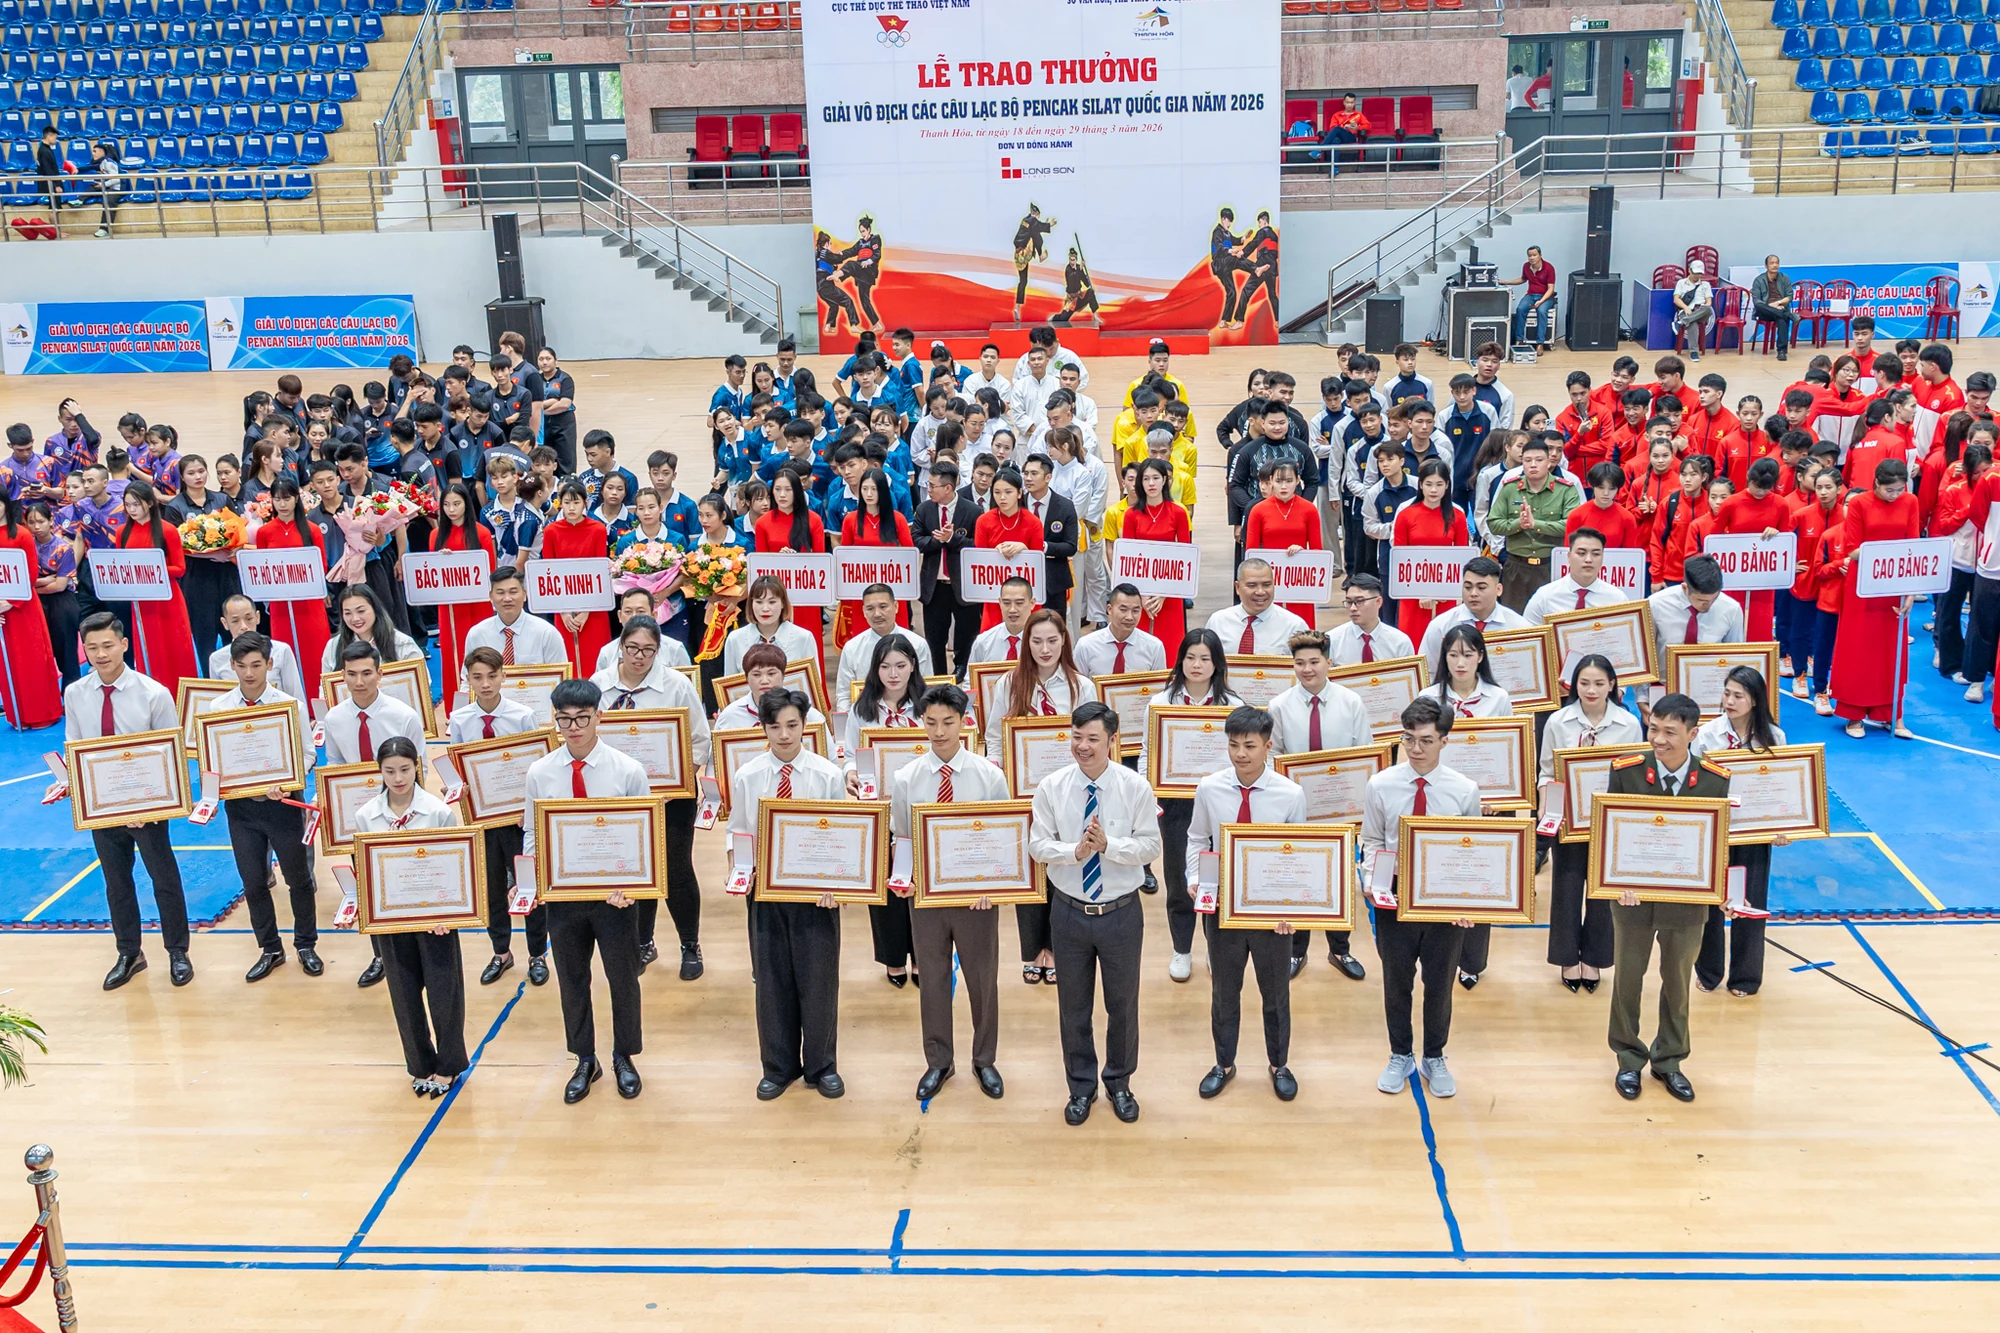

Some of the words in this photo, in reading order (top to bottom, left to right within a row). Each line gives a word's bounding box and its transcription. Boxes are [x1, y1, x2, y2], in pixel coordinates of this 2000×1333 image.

[832, 3, 848, 14] CỤC
[868, 2, 885, 13] DỤC
[906, 0, 928, 9] THAO
[918, 53, 951, 88] LỄ
[959, 60, 1032, 87] TRAO
[1040, 51, 1157, 85] THƯỞNG
[823, 101, 851, 122] GIẢI
[854, 101, 872, 121] VÔ
[876, 103, 908, 124] ĐỊCH
[912, 100, 937, 120] CÁC
[941, 98, 967, 119] CÂU
[971, 100, 997, 121] LẠC
[1001, 97, 1019, 120] BỘ
[1023, 99, 1078, 117] PENCAK
[1082, 97, 1122, 115] SILAT
[1126, 91, 1161, 117] QUỐC
[1165, 96, 1189, 113] GIA
[1192, 91, 1226, 112] NĂM
[1231, 93, 1264, 111] 2026
[920, 129, 948, 138] Thanh
[952, 127, 973, 138] Hóa,
[976, 127, 986, 137] từ
[988, 127, 1010, 138] ngày
[1013, 127, 1023, 136] 18
[1025, 124, 1042, 135] đến
[1044, 126, 1066, 137] ngày
[1069, 126, 1080, 134] 29
[1082, 125, 1108, 135] tháng
[1111, 125, 1116, 133] 3
[1119, 125, 1138, 133] năm
[1141, 124, 1163, 132] 2026
[1017, 142, 1024, 150] VỊ
[1855, 285, 1874, 299] CÁC
[1877, 284, 1898, 299] CÂU
[1902, 286, 1922, 301] LẠC
[1878, 305, 1895, 317] GIA
[1898, 303, 1923, 317] NĂM
[49, 322, 69, 336] GIẢI
[71, 322, 84, 335] VÔ
[87, 323, 110, 337] ĐỊCH
[112, 322, 131, 334] CÁC
[133, 321, 152, 334] CÂU
[154, 323, 174, 336] LẠC
[176, 320, 189, 336] BỘ
[255, 316, 275, 330] GIẢI
[279, 316, 291, 329] VÔ
[294, 317, 316, 331] ĐỊCH
[319, 316, 338, 329] CÁC
[341, 314, 360, 329] CÂU
[362, 317, 381, 331] LẠC
[384, 314, 397, 331] BỘ
[42, 342, 78, 354] PENCAK
[81, 342, 106, 353] SILAT
[109, 337, 133, 354] QUỐC
[136, 341, 151, 352] GIA
[153, 338, 176, 352] NĂM
[179, 340, 201, 351] 2026
[248, 337, 284, 348] PENCAK
[287, 336, 313, 348] SILAT
[316, 332, 340, 349] QUỐC
[343, 336, 358, 346] GIA
[361, 333, 383, 346] NĂM
[386, 335, 409, 346] 2026
[1120, 553, 1149, 578] TUYÊN
[1152, 559, 1183, 582] QUANG
[1187, 562, 1192, 581] 1
[1741, 543, 1777, 572] BẰNG
[1782, 551, 1787, 571] 1
[1873, 557, 1894, 579] CAO
[1898, 548, 1927, 577] BẰNG
[1931, 555, 1938, 575] 2
[13, 565, 19, 584] 1
[95, 565, 108, 584] TP.
[109, 558, 119, 584] HỒ
[120, 560, 134, 584] CHÍ
[136, 565, 154, 584] MINH
[156, 566, 163, 584] 2
[248, 566, 261, 585] TP.
[261, 559, 272, 585] HỒ
[273, 560, 286, 584] CHÍ
[288, 565, 307, 583] MINH
[308, 565, 314, 583] 1
[415, 561, 438, 589] BẮC
[441, 566, 471, 587] NINH
[474, 566, 481, 585] 2
[538, 568, 561, 597] BẮC
[565, 574, 593, 594] NINH
[596, 574, 602, 593] 1
[795, 565, 816, 589] HÓA
[819, 569, 825, 589] 2
[842, 562, 877, 583] THANH
[880, 559, 902, 583] HÓA
[905, 564, 911, 584] 1
[971, 564, 1012, 590] TRỌNG
[1284, 566, 1316, 588] QUANG
[1319, 567, 1325, 587] 2
[1398, 558, 1412, 588] BỘ
[1415, 558, 1443, 583] CÔNG
[1446, 563, 1460, 583] AN
[1611, 566, 1625, 587] AN
[1629, 567, 1635, 587] 2
